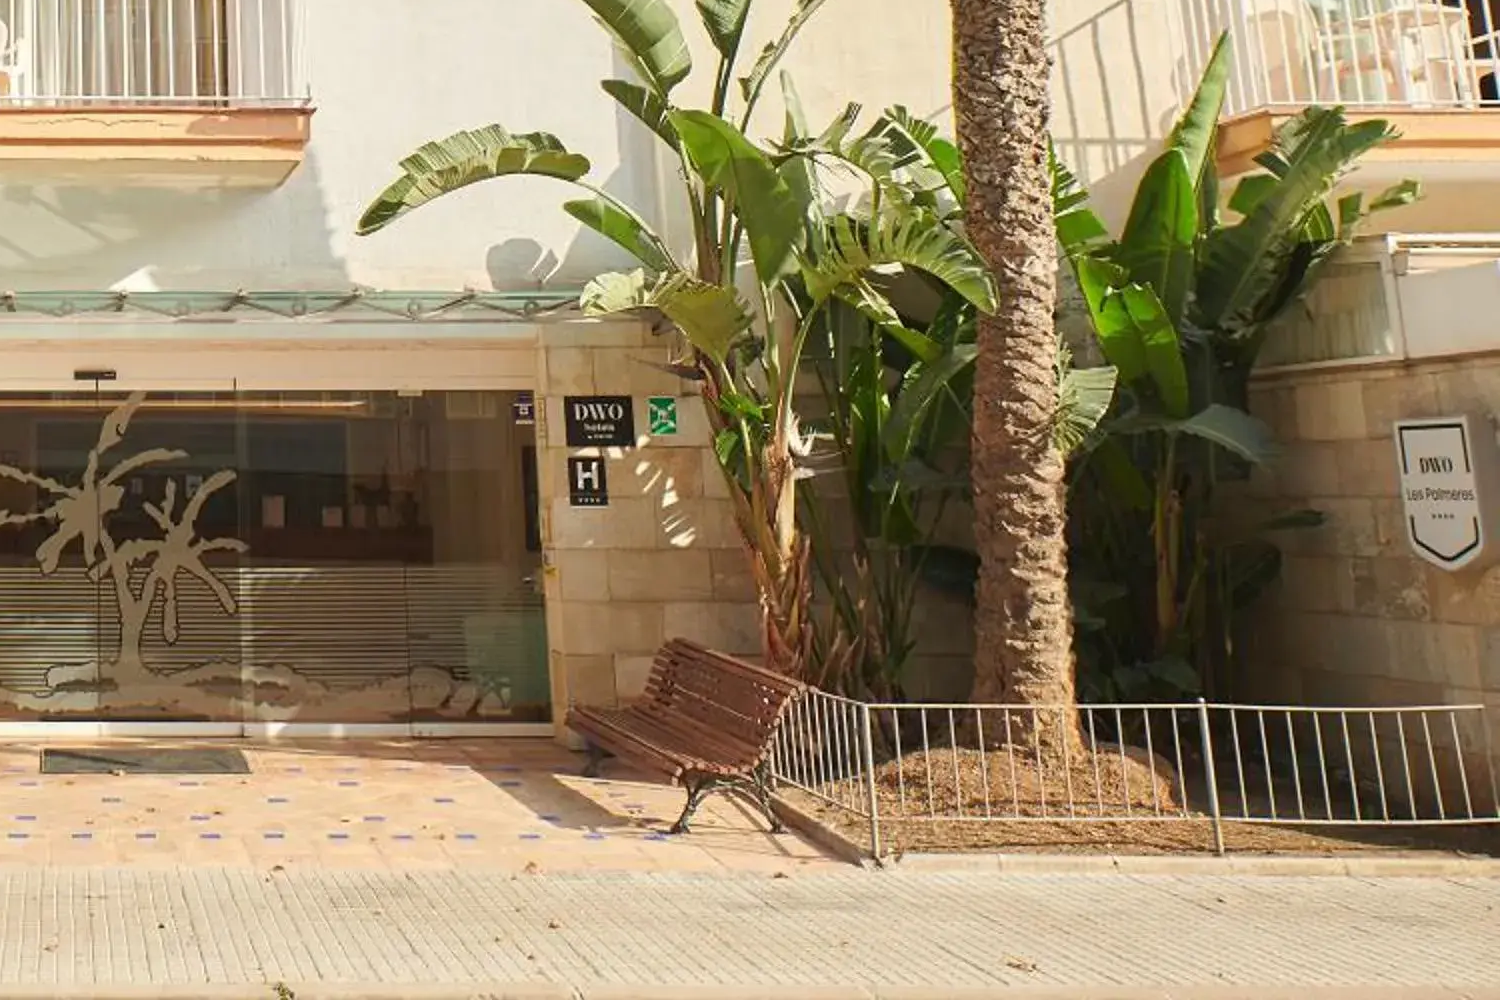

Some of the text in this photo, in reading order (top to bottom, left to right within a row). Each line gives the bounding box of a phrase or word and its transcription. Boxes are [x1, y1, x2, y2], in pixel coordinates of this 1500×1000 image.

[574, 403, 624, 421] DWO
[1419, 457, 1453, 474] DWO
[576, 462, 599, 490] H
